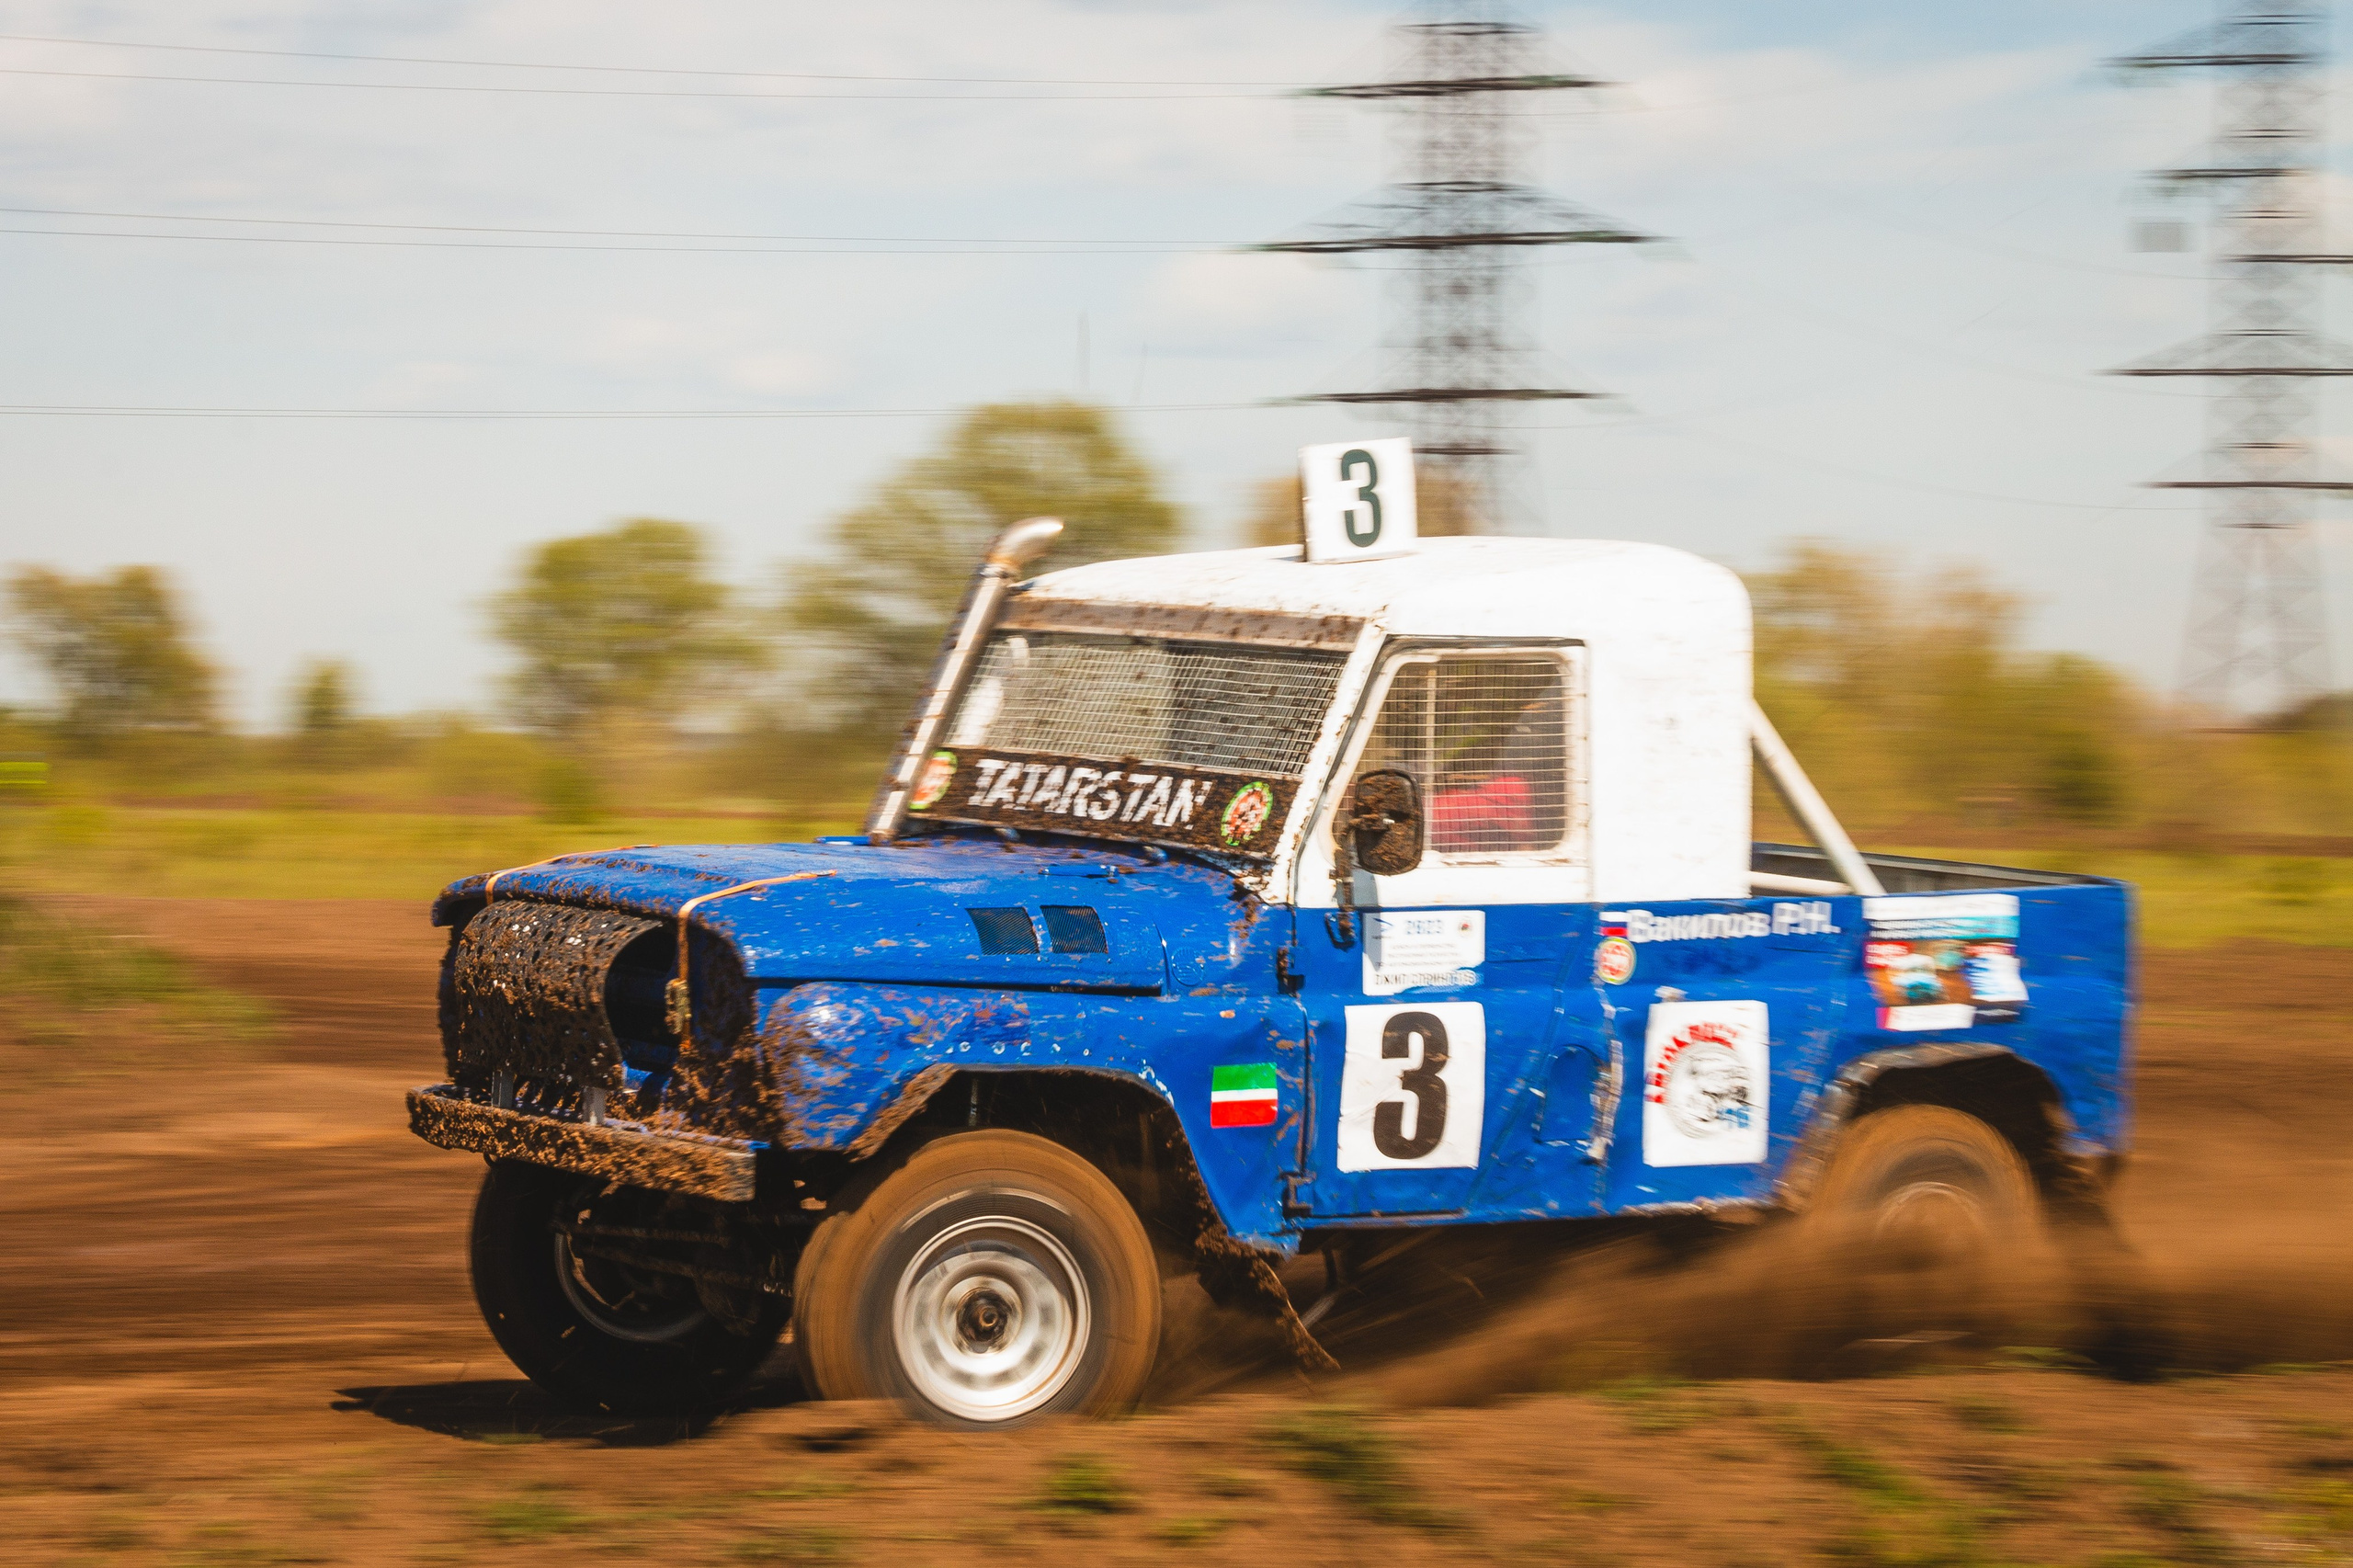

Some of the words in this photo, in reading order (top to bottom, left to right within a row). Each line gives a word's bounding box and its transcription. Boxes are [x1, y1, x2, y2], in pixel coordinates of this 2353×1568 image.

[1341, 449, 1381, 548] 3
[967, 758, 1213, 830] TATARSTAN
[1373, 1011, 1449, 1160] 3
